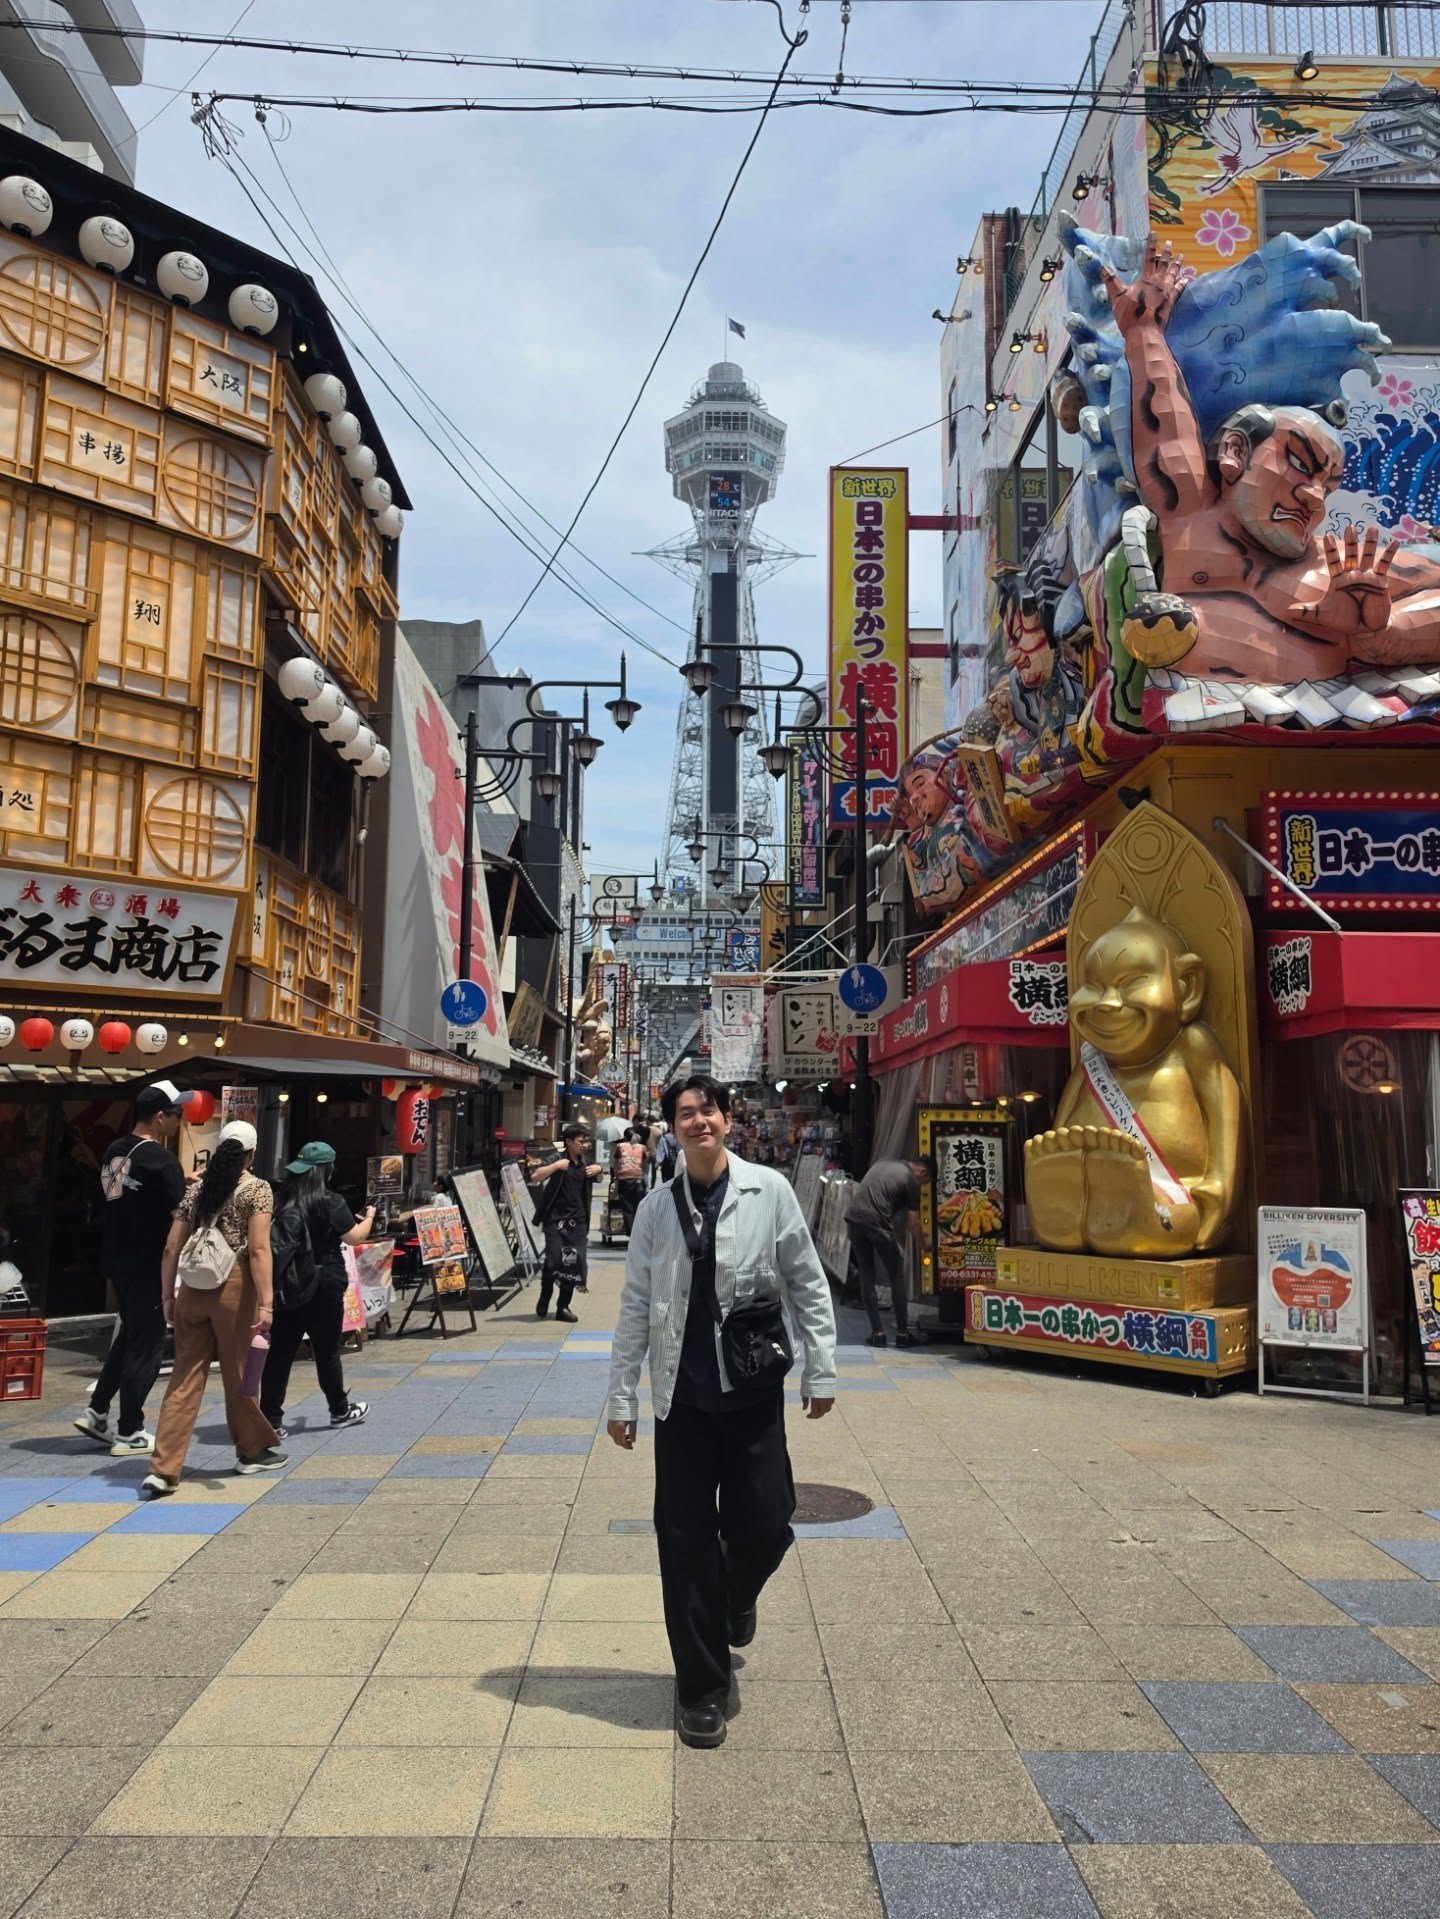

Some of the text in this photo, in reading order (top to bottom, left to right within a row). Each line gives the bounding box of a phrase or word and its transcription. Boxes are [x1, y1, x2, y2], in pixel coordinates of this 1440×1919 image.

[200, 365, 243, 397] 大阪
[78, 431, 126, 465] 串揚
[718, 482, 730, 491] 28
[718, 498, 730, 507] 54
[842, 478, 896, 498] 新世界
[853, 501, 885, 658] 日本一の串かつ
[134, 599, 161, 627] 翔
[839, 662, 899, 780] 横綱
[0, 786, 34, 811] 処
[840, 787, 899, 816] 名門
[1289, 819, 1315, 886] 新世界
[125, 893, 182, 921] 酒場
[1269, 939, 1311, 960] 日本一の串かつ
[1270, 953, 1310, 1001] 横綱
[448, 1031, 477, 1040] 9-22
[847, 1022, 876, 1033] 9-22
[412, 1099, 430, 1145] おでん
[952, 1139, 986, 1192] 横綱
[1263, 1212, 1304, 1220] BILLIKEN
[1306, 1213, 1358, 1222] DIVERSITY
[1017, 1259, 1157, 1301] BILLIKEN
[973, 1293, 983, 1328] 新世界
[986, 1298, 1188, 1355] 日本一の串かつ 横綱
[1190, 1320, 1208, 1357] 名門
